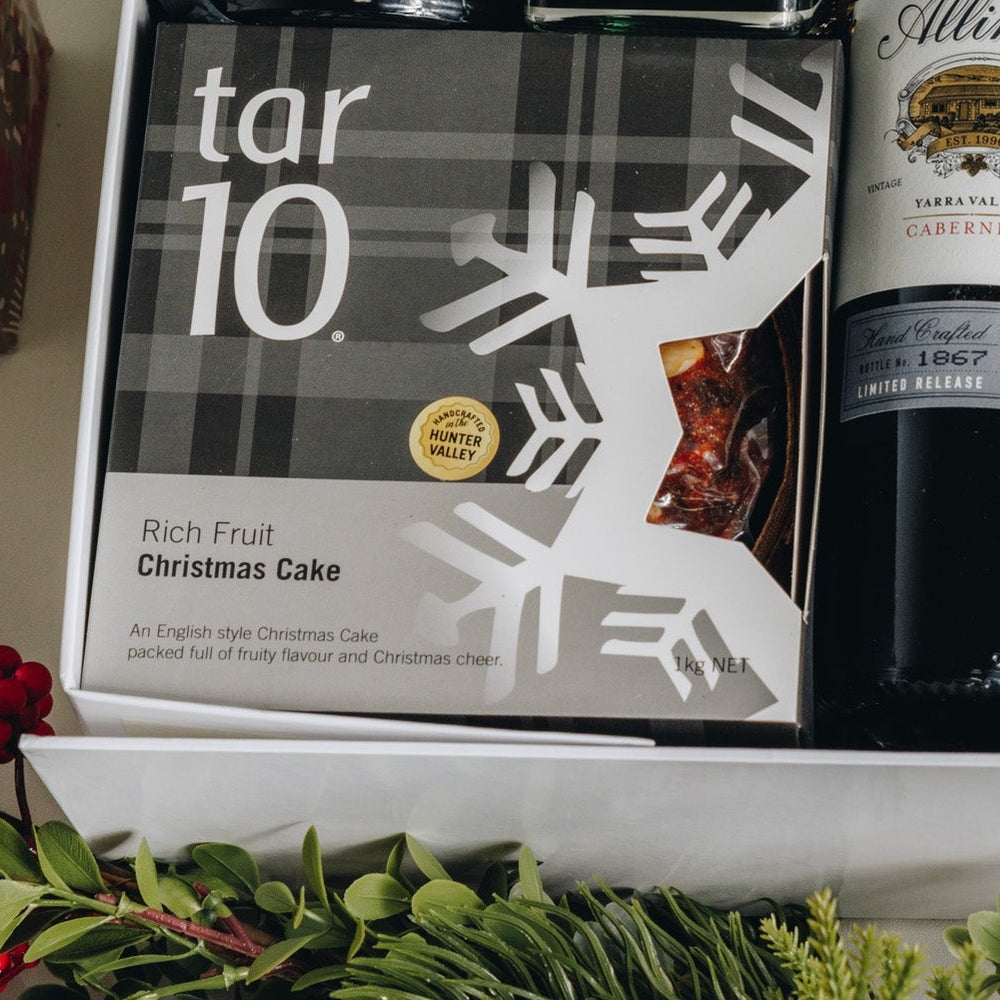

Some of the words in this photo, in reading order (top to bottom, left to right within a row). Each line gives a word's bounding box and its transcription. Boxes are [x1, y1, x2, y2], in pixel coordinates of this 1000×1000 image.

[194, 67, 371, 164] tar
[946, 136, 971, 147] EST.
[915, 196, 964, 209] YARRA
[864, 325, 914, 349] Hand
[914, 318, 991, 342] Crafted
[918, 350, 988, 366] 1867
[858, 378, 906, 399] LIMITED
[916, 376, 983, 390] RELEASE
[433, 409, 485, 432] HANDCRAFTED
[429, 429, 481, 447] HUNTER
[429, 444, 476, 462] VALLEY
[142, 519, 201, 545] Rich
[213, 522, 274, 547] Fruit
[137, 554, 266, 581] Christmas
[276, 557, 341, 582] Cake
[129, 624, 151, 638] An
[156, 624, 213, 642] English
[217, 625, 253, 642] style
[257, 627, 335, 643] Christmas
[339, 629, 379, 644] Cake
[127, 645, 185, 662] packed
[190, 645, 213, 660] full
[217, 646, 232, 660] of
[237, 647, 276, 665] fruity
[281, 648, 333, 665] flavour
[338, 651, 367, 665] and
[373, 650, 451, 667] Christmas
[455, 651, 502, 667] cheer.
[673, 655, 704, 676] 1kg
[712, 656, 749, 673] NET
